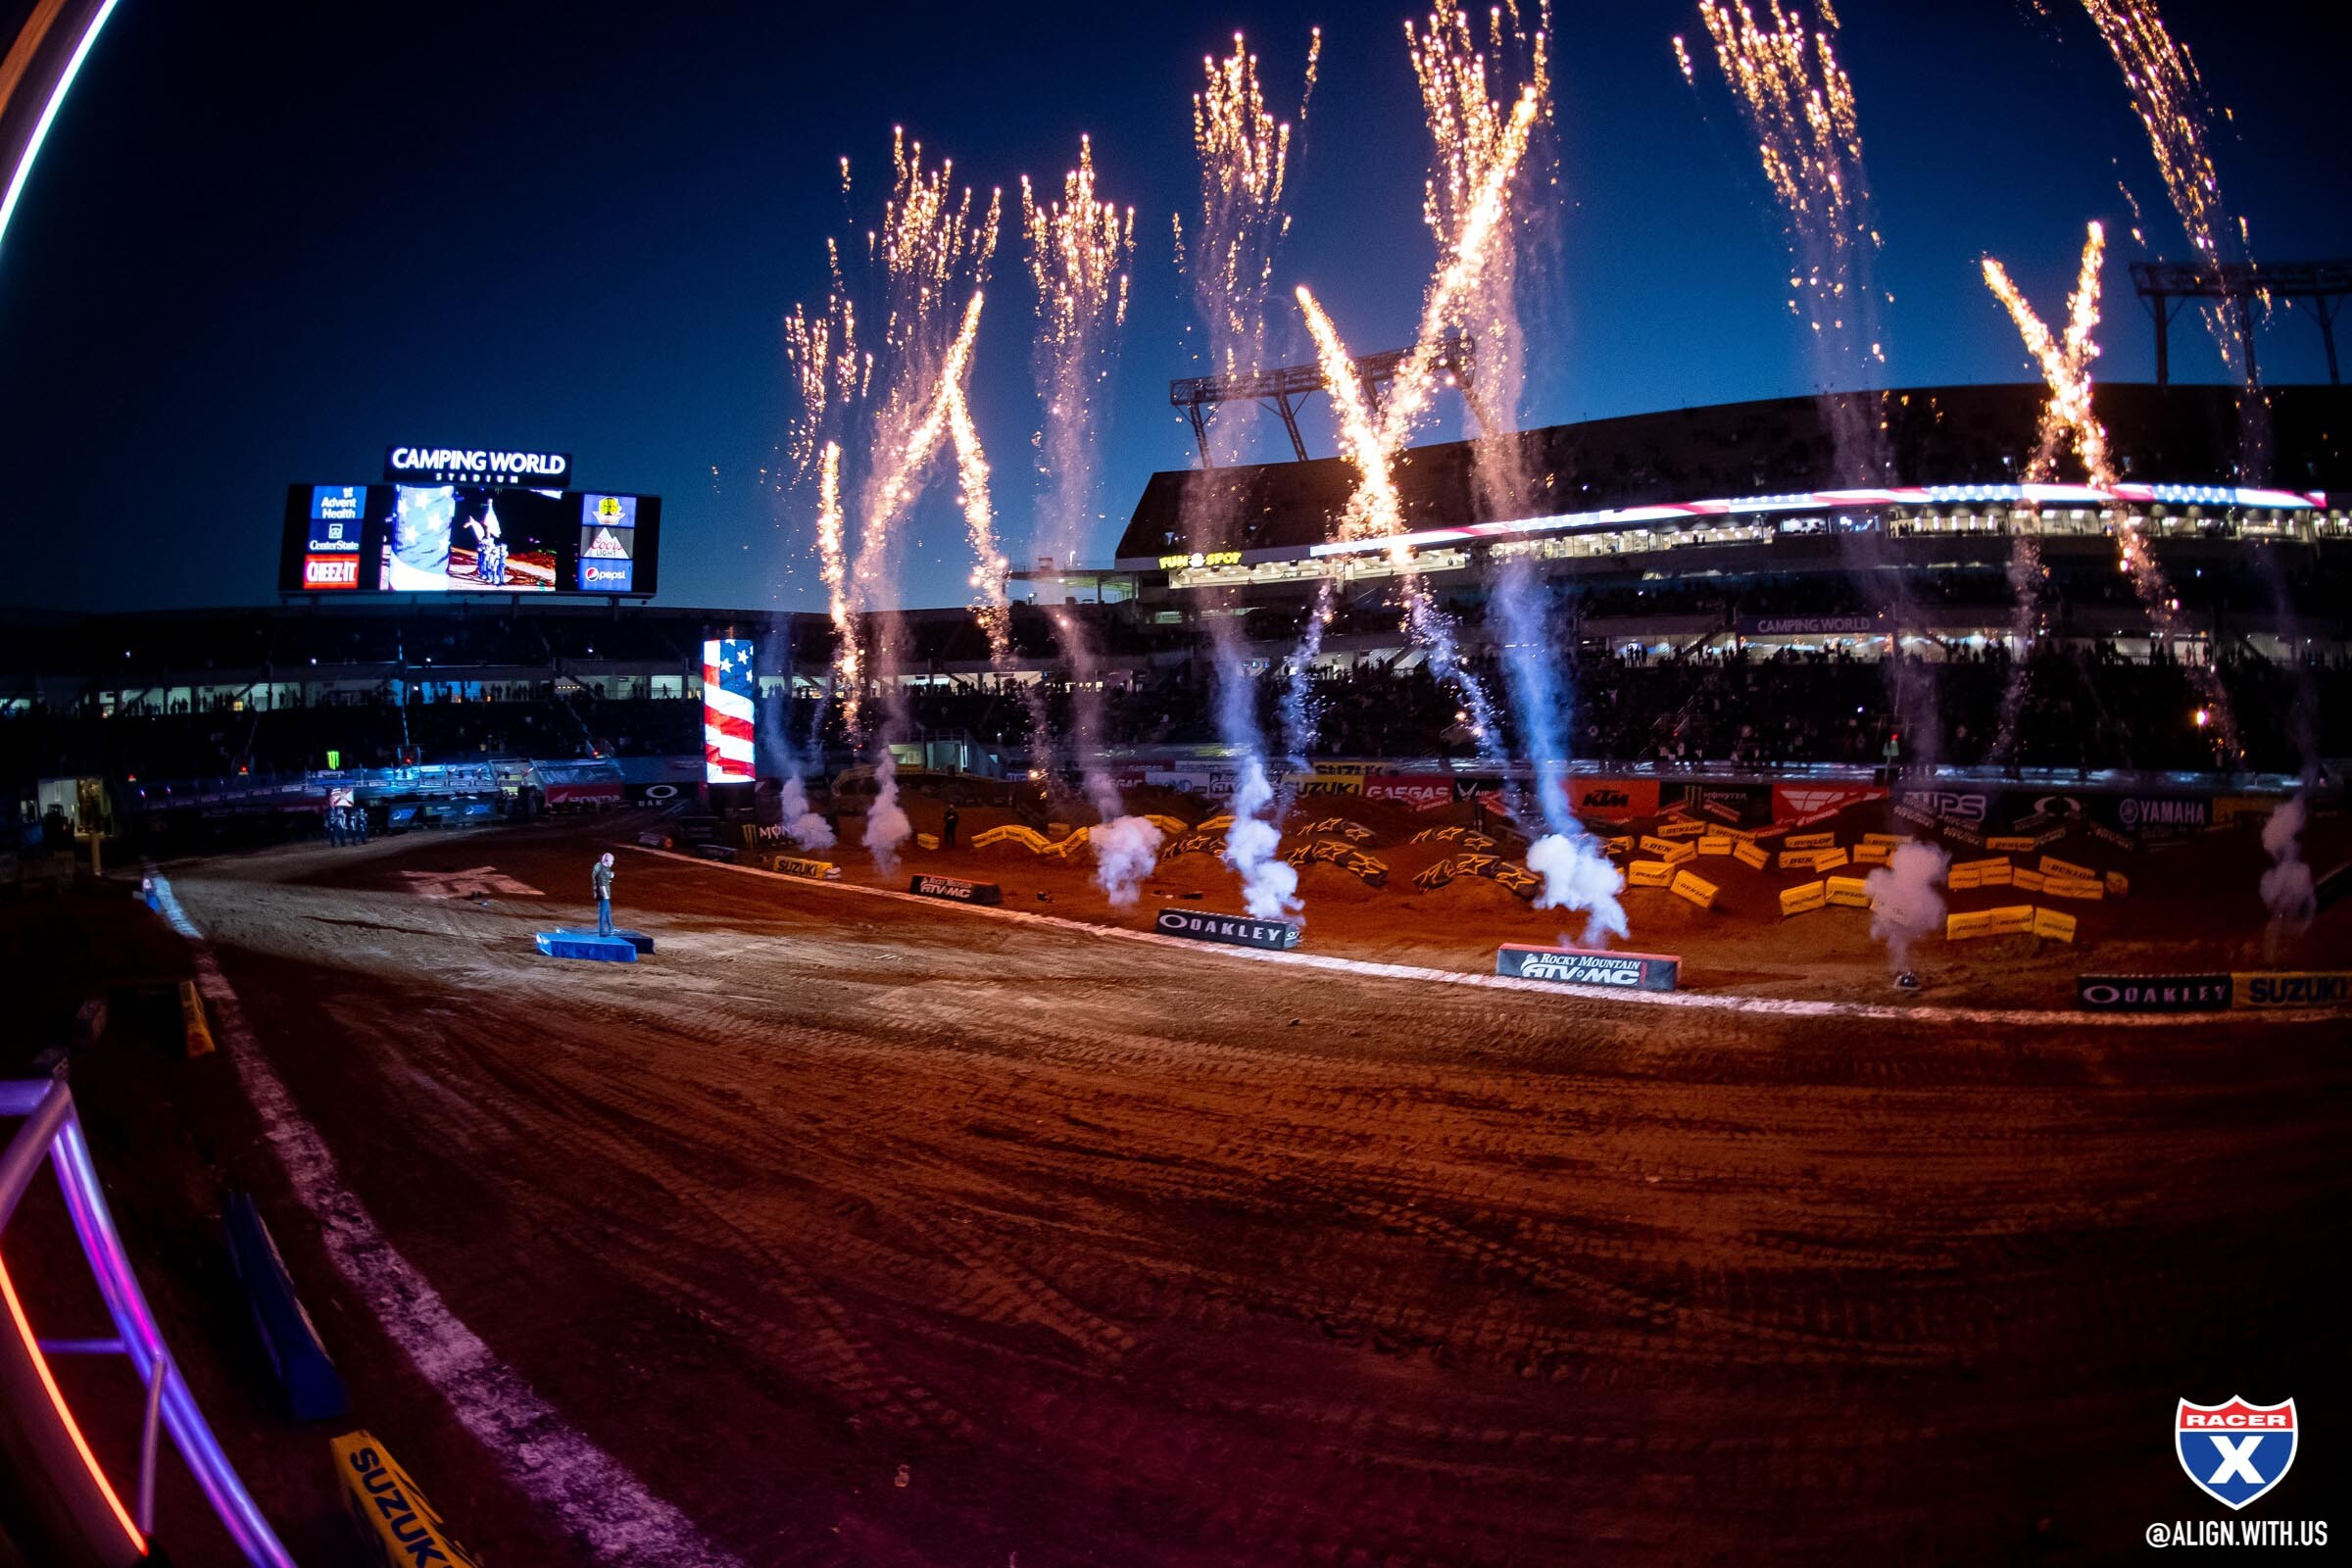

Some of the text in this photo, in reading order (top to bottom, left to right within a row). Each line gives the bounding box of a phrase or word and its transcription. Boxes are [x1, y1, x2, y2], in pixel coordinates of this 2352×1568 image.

[392, 448, 566, 474] CAMPING WORLD
[436, 473, 518, 483] STADIUM
[321, 497, 357, 508] Advent
[322, 509, 356, 518] Health
[310, 540, 360, 551] CenterState
[591, 537, 622, 550] Coors
[1159, 552, 1242, 568] FUN SPOT
[599, 570, 626, 580] pepsi
[1757, 617, 1870, 633] CAMPING WORLD
[1583, 790, 1629, 807] KTM
[2140, 801, 2204, 823] YAMAHA
[777, 859, 817, 876] SUZUKI
[1189, 918, 1281, 942] OAKLEY
[1540, 953, 1642, 970] ROCKY MOUNTAIN
[2125, 984, 2226, 1004] OAKLEY
[2250, 978, 2347, 1003] SUZUKI
[350, 1447, 450, 1568] SUZUK
